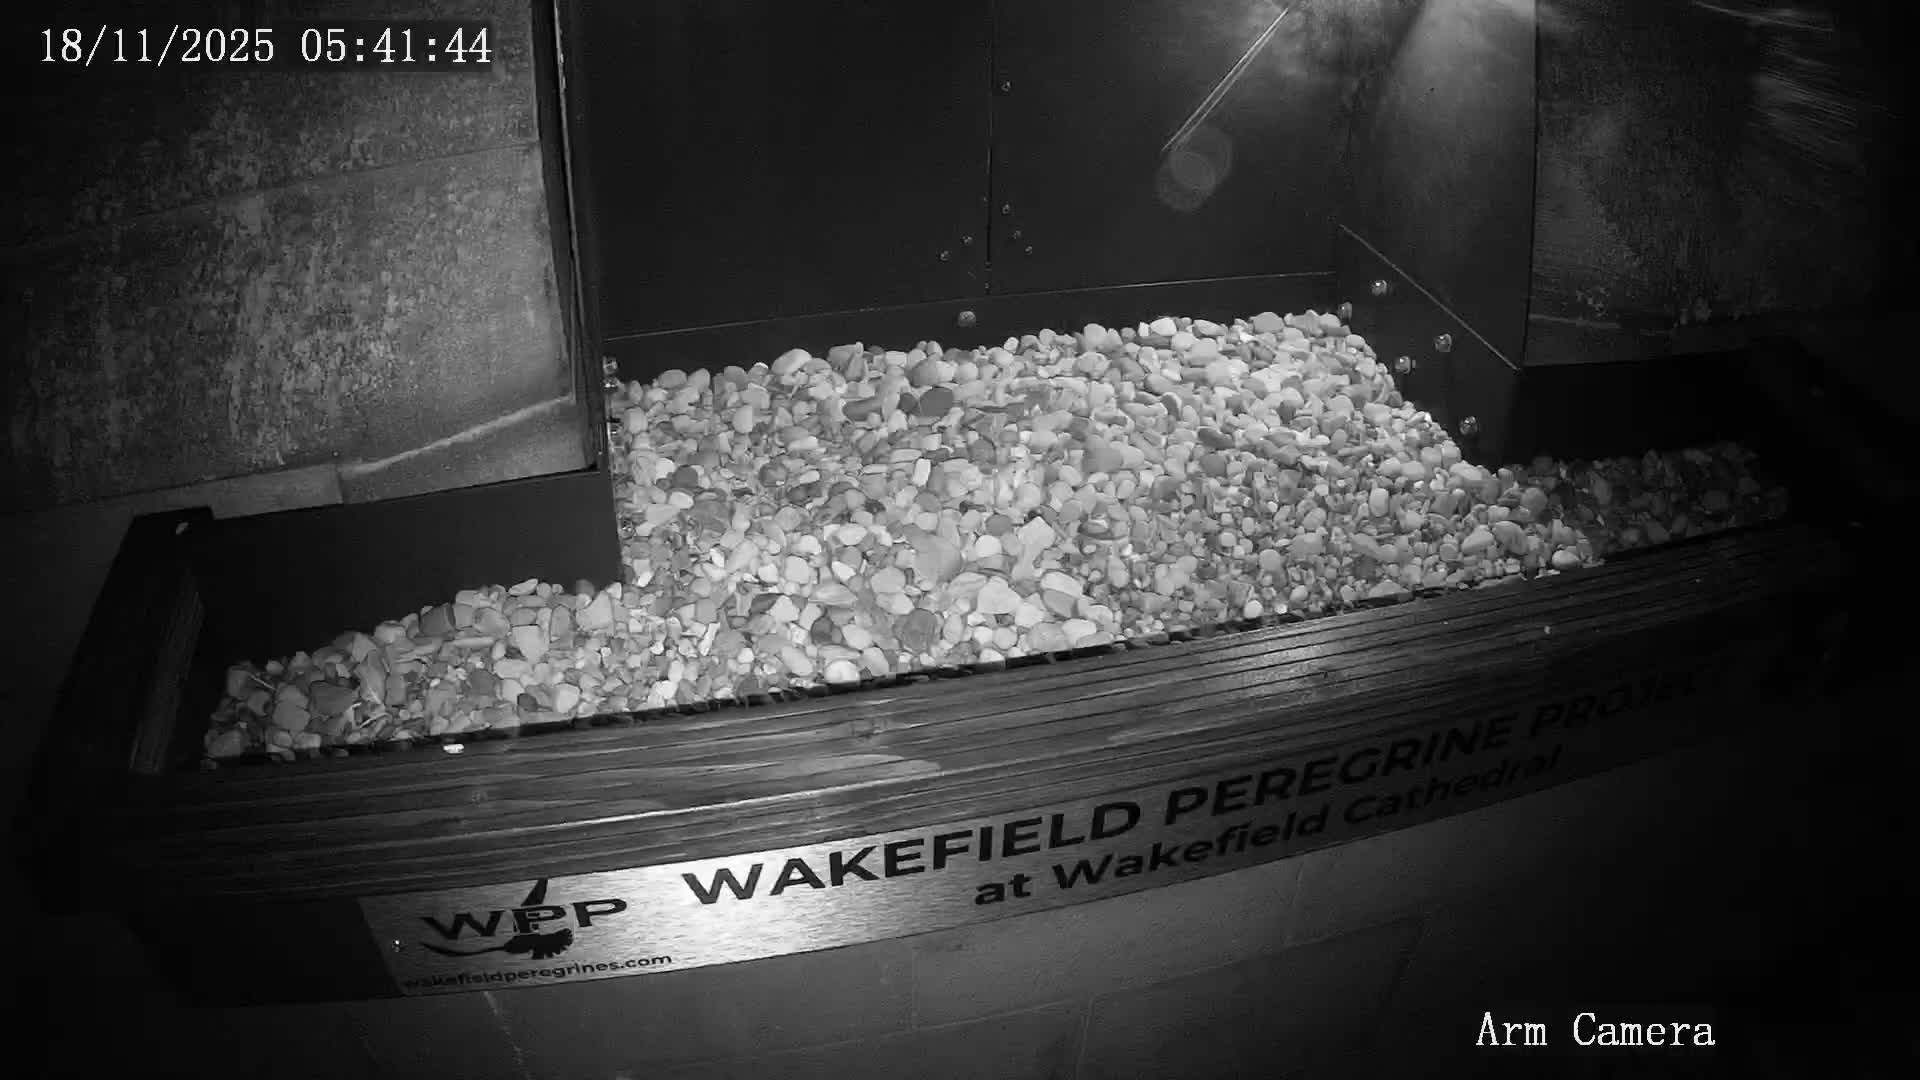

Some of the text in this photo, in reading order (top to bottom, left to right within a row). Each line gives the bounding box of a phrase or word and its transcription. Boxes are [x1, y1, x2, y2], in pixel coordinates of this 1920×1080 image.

[681, 801, 1142, 905] WAKEFIELD
[1164, 712, 1519, 825] PEREGRINE
[973, 743, 1563, 905] at Wakefield Cathedral
[420, 897, 628, 941] WPP
